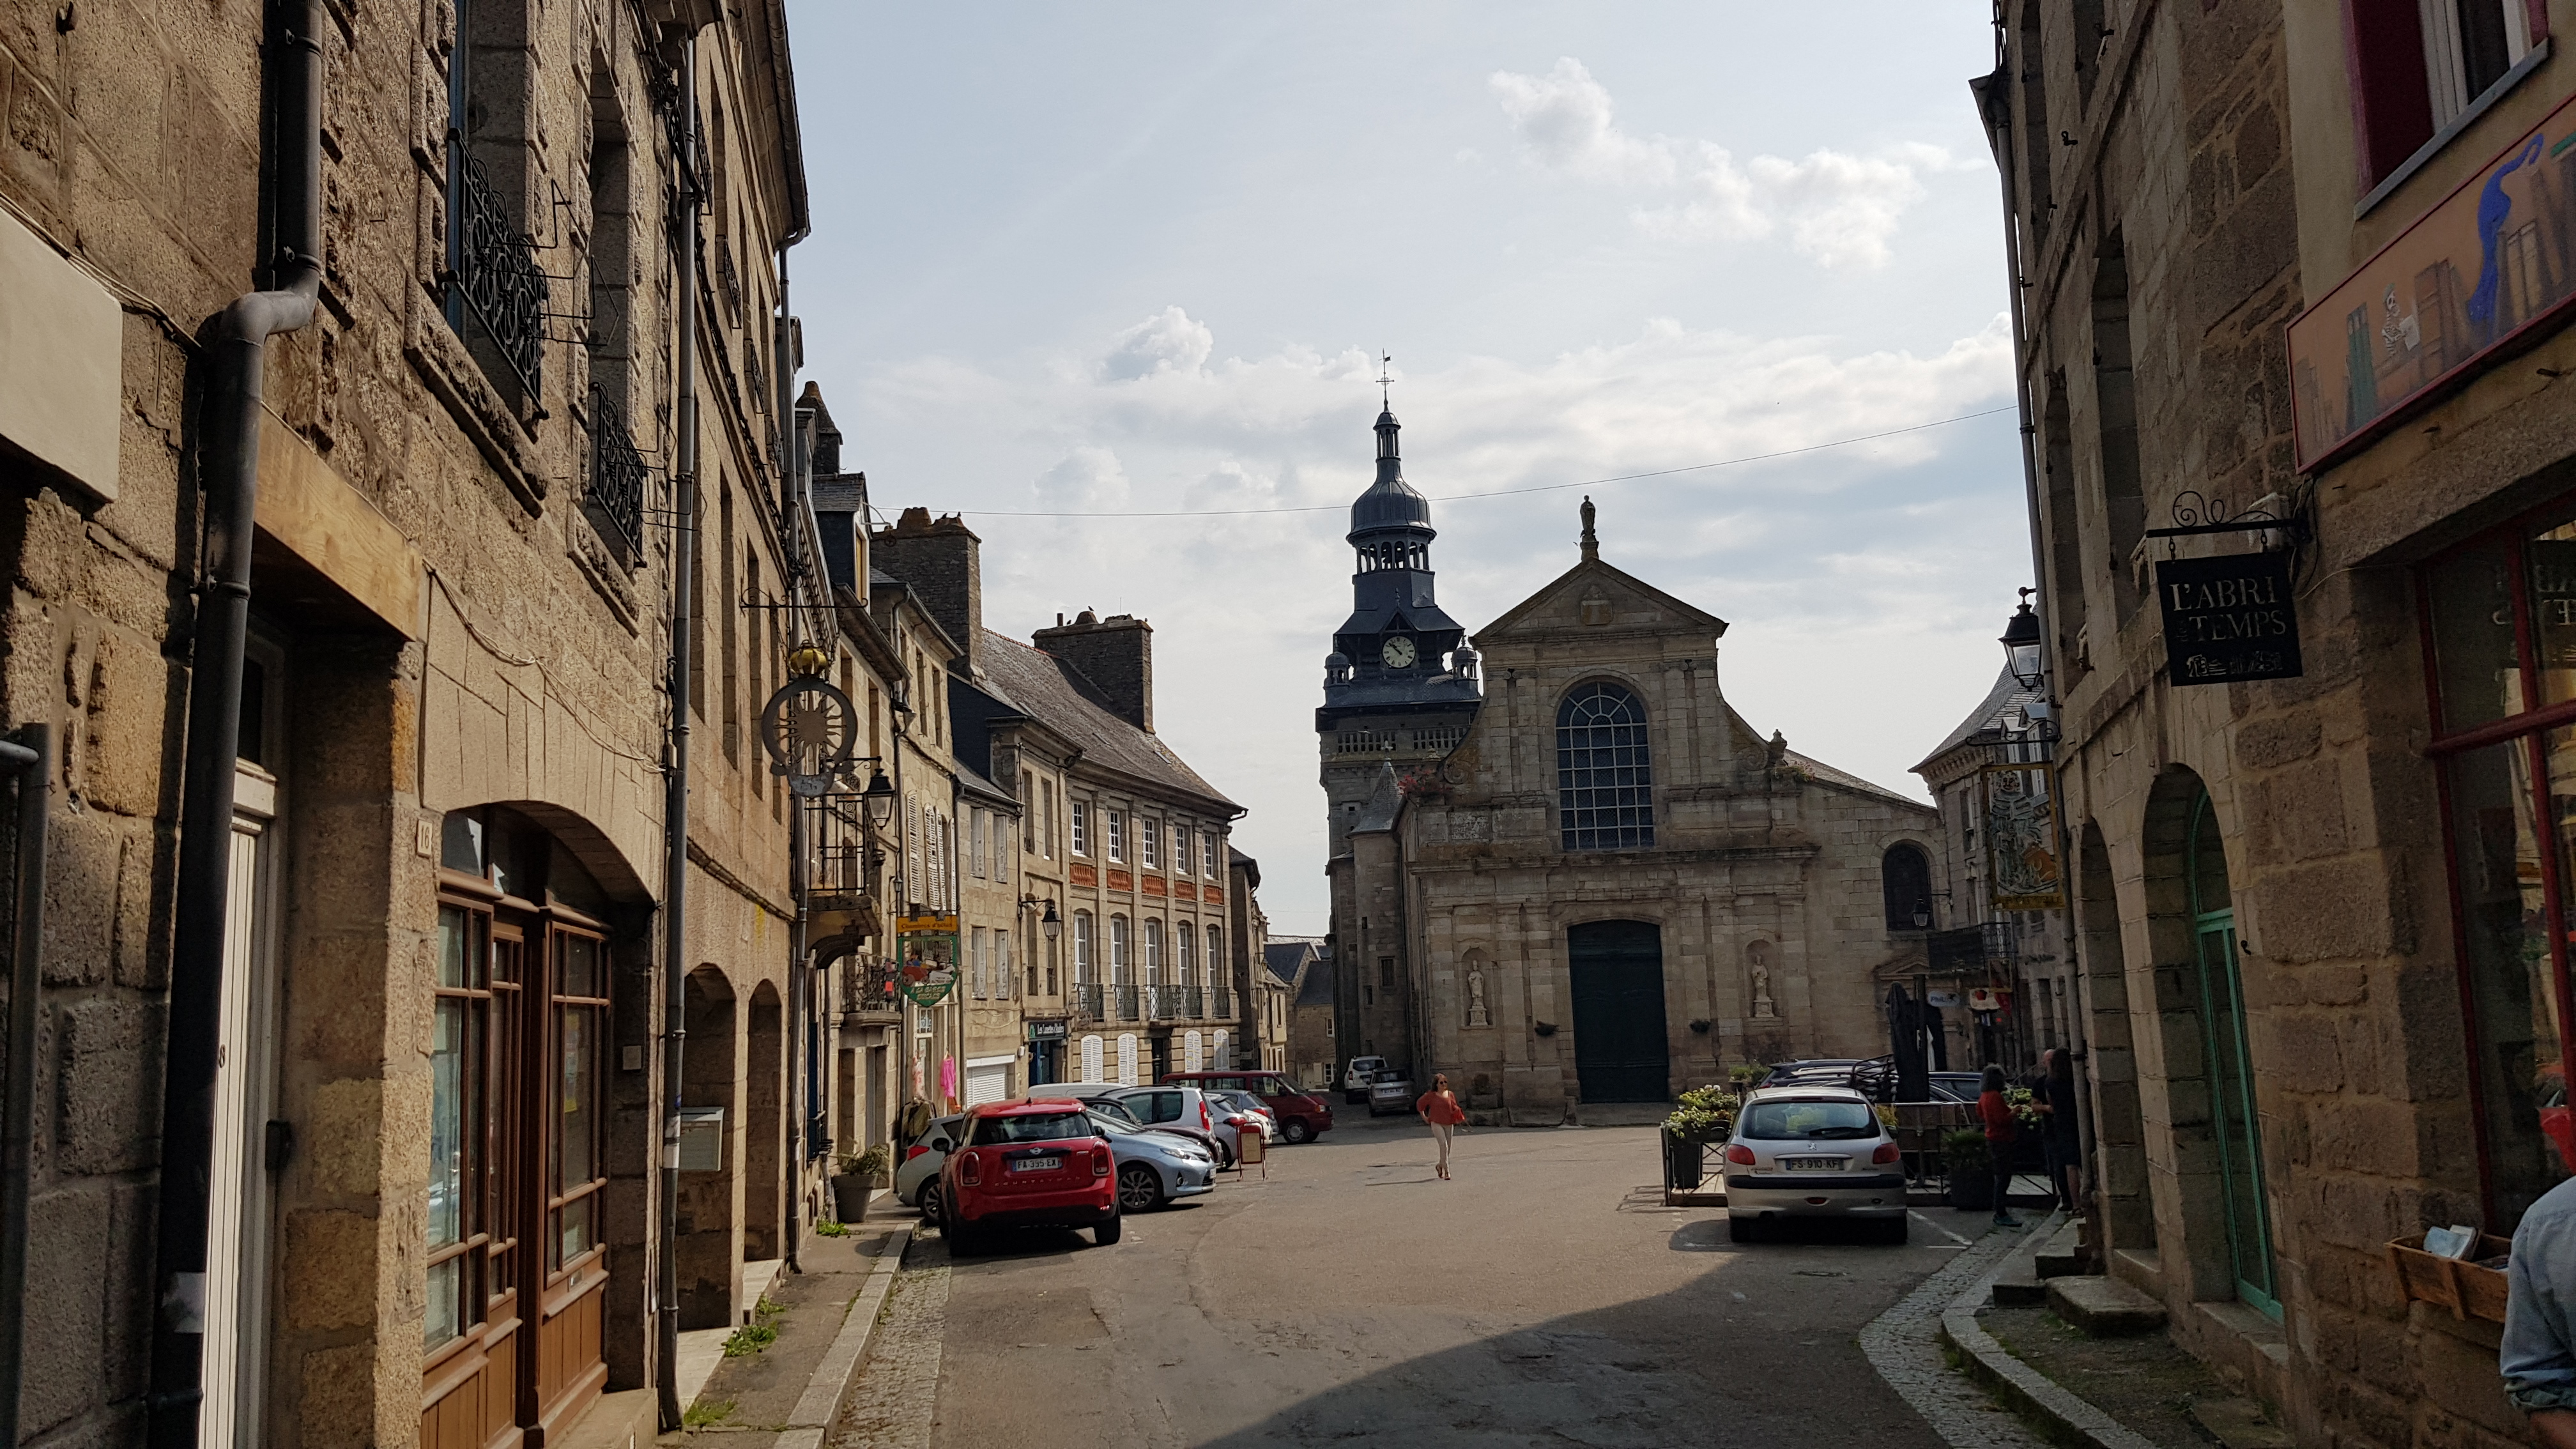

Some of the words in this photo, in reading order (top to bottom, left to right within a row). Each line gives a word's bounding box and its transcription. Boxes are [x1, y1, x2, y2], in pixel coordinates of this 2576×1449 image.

[2169, 576, 2280, 611] L'ABRI
[2189, 610, 2287, 643] TEMPS
[420, 825, 430, 849] 16
[1791, 1158, 1839, 1169] FS-910-KF
